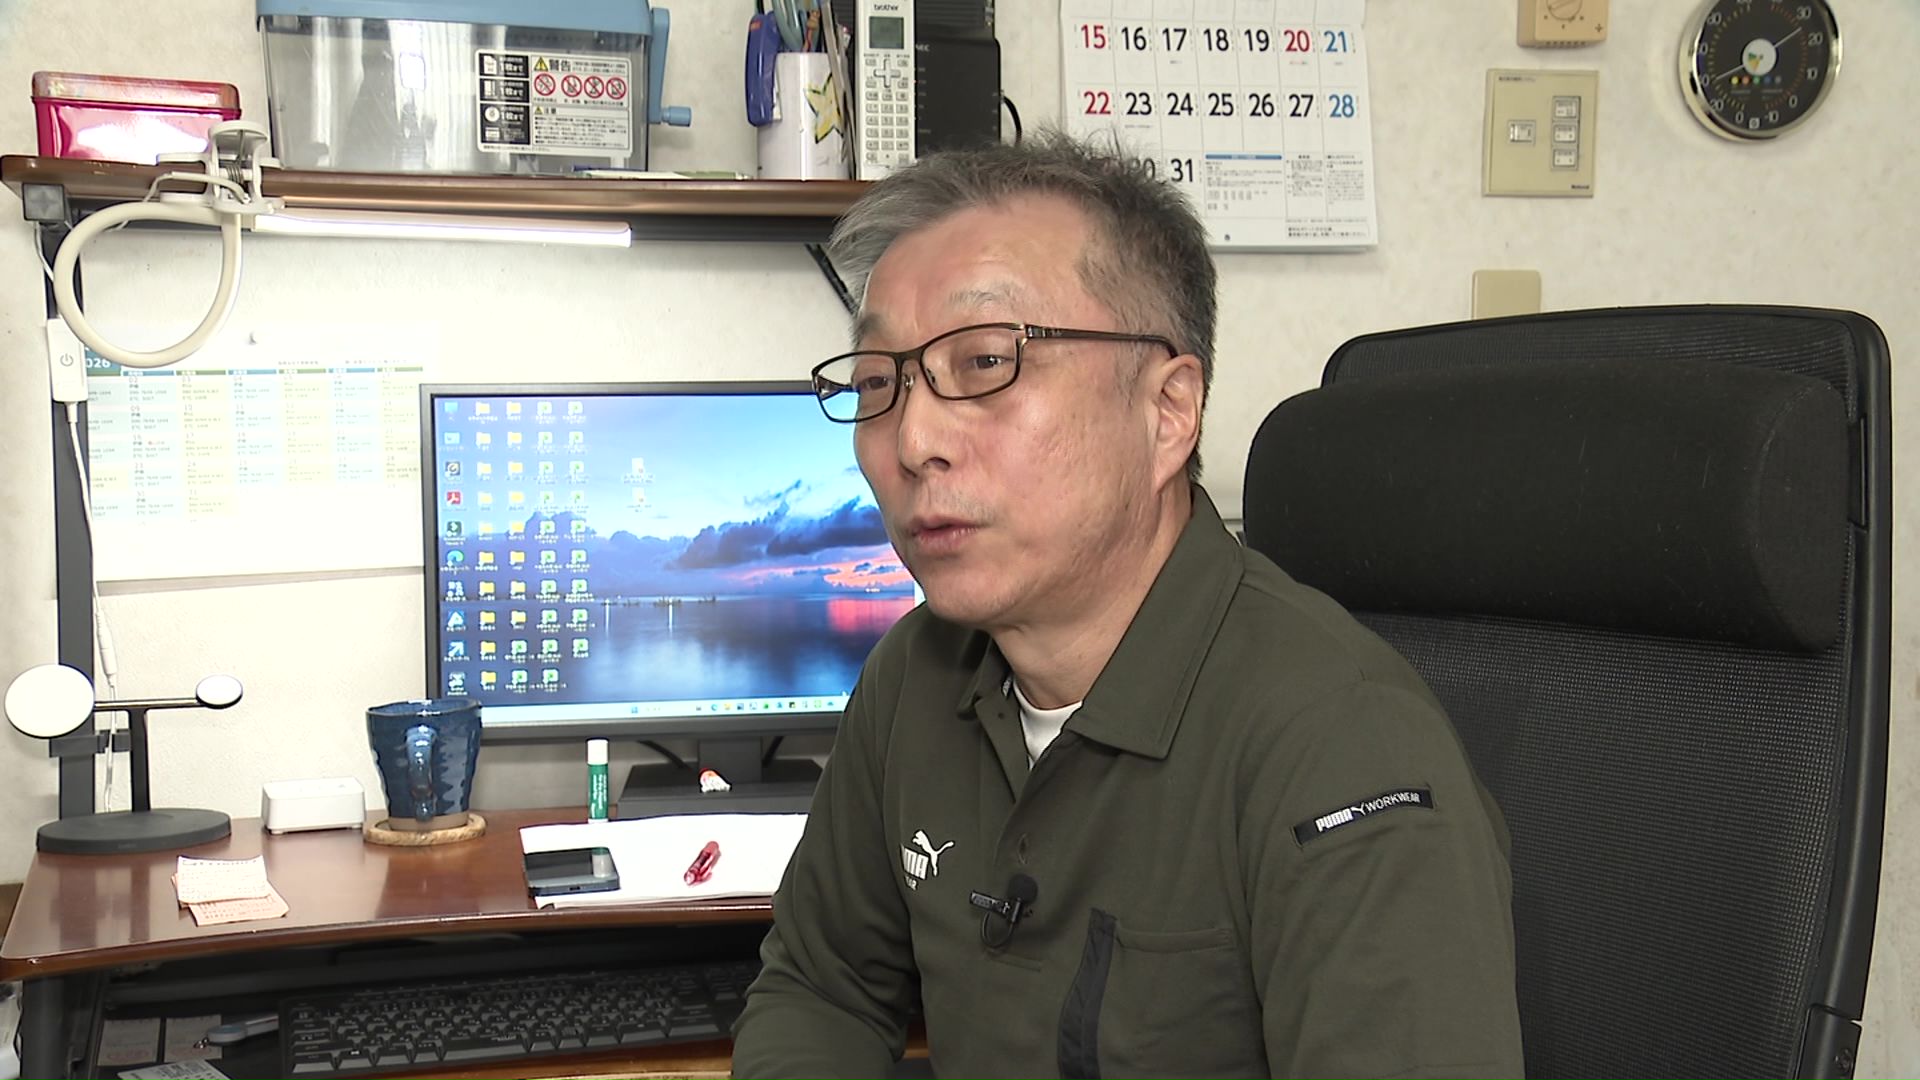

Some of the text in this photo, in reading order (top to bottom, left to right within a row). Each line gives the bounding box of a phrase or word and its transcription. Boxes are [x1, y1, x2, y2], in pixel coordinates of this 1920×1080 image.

[1797, 6, 1811, 19] 30
[1081, 24, 1347, 52] 15 16 17 18 19 20 21
[1808, 32, 1823, 46] 20
[1806, 67, 1818, 81] 10
[1084, 91, 1355, 118] 22 23 24 25 26 27 28
[1789, 95, 1798, 109] 0
[1735, 111, 1744, 124] 0
[1170, 158, 1194, 182] 31
[1315, 791, 1421, 832] PUMA WORKWEAR
